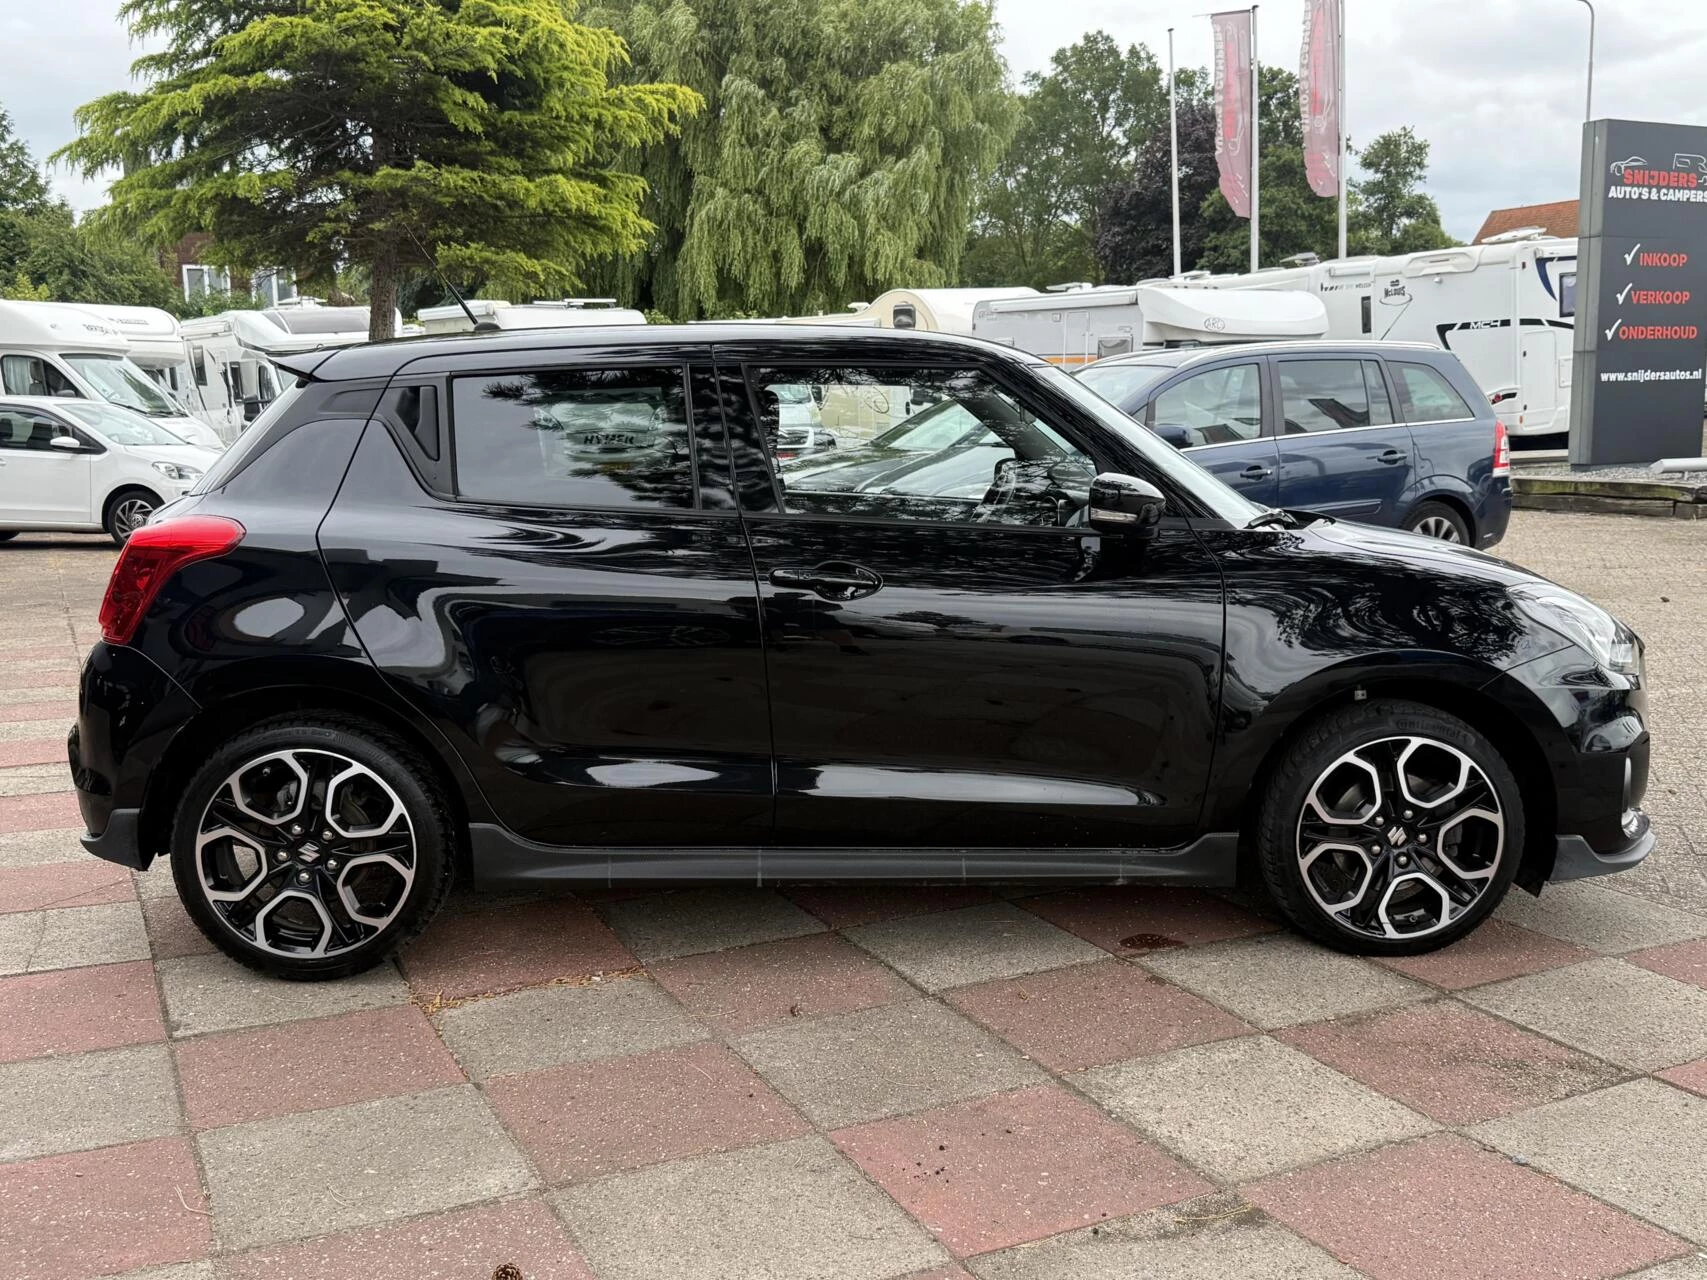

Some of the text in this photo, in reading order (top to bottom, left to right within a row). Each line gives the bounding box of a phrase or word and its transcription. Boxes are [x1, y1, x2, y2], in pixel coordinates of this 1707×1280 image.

[1623, 168, 1697, 188] SNIJDERS
[1608, 185, 1649, 200] AUTO'S
[1650, 188, 1658, 200] &
[1640, 252, 1688, 266] INKOOP
[1631, 290, 1690, 304] VERKOOP
[1469, 320, 1500, 330] MC4
[1619, 326, 1698, 339] ONDERHOUD
[1600, 368, 1702, 382] www.snijdersautos.nl
